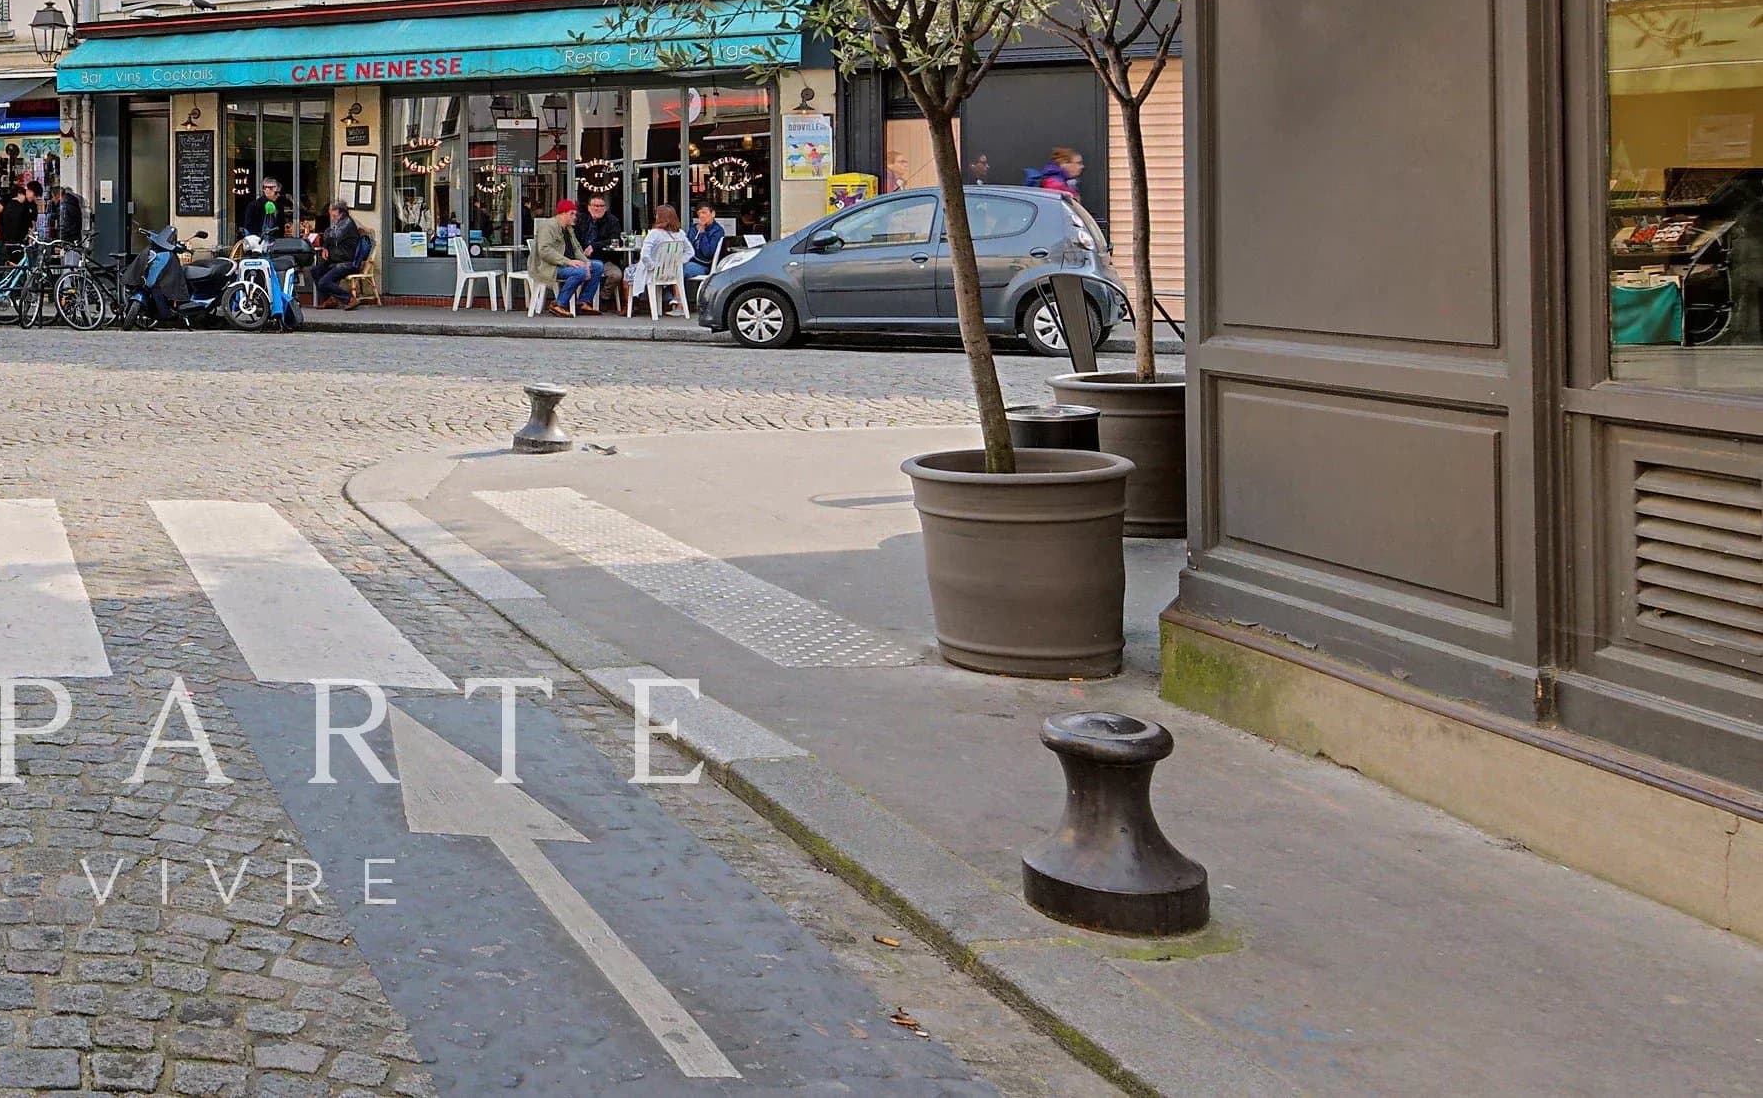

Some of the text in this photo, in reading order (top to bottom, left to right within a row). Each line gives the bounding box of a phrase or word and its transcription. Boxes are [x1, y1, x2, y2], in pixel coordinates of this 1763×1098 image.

[565, 49, 610, 64] Resto
[81, 68, 214, 84] Bar Vins Cocktails
[291, 57, 463, 82] CAFE NENESSE
[409, 137, 443, 150] Chez
